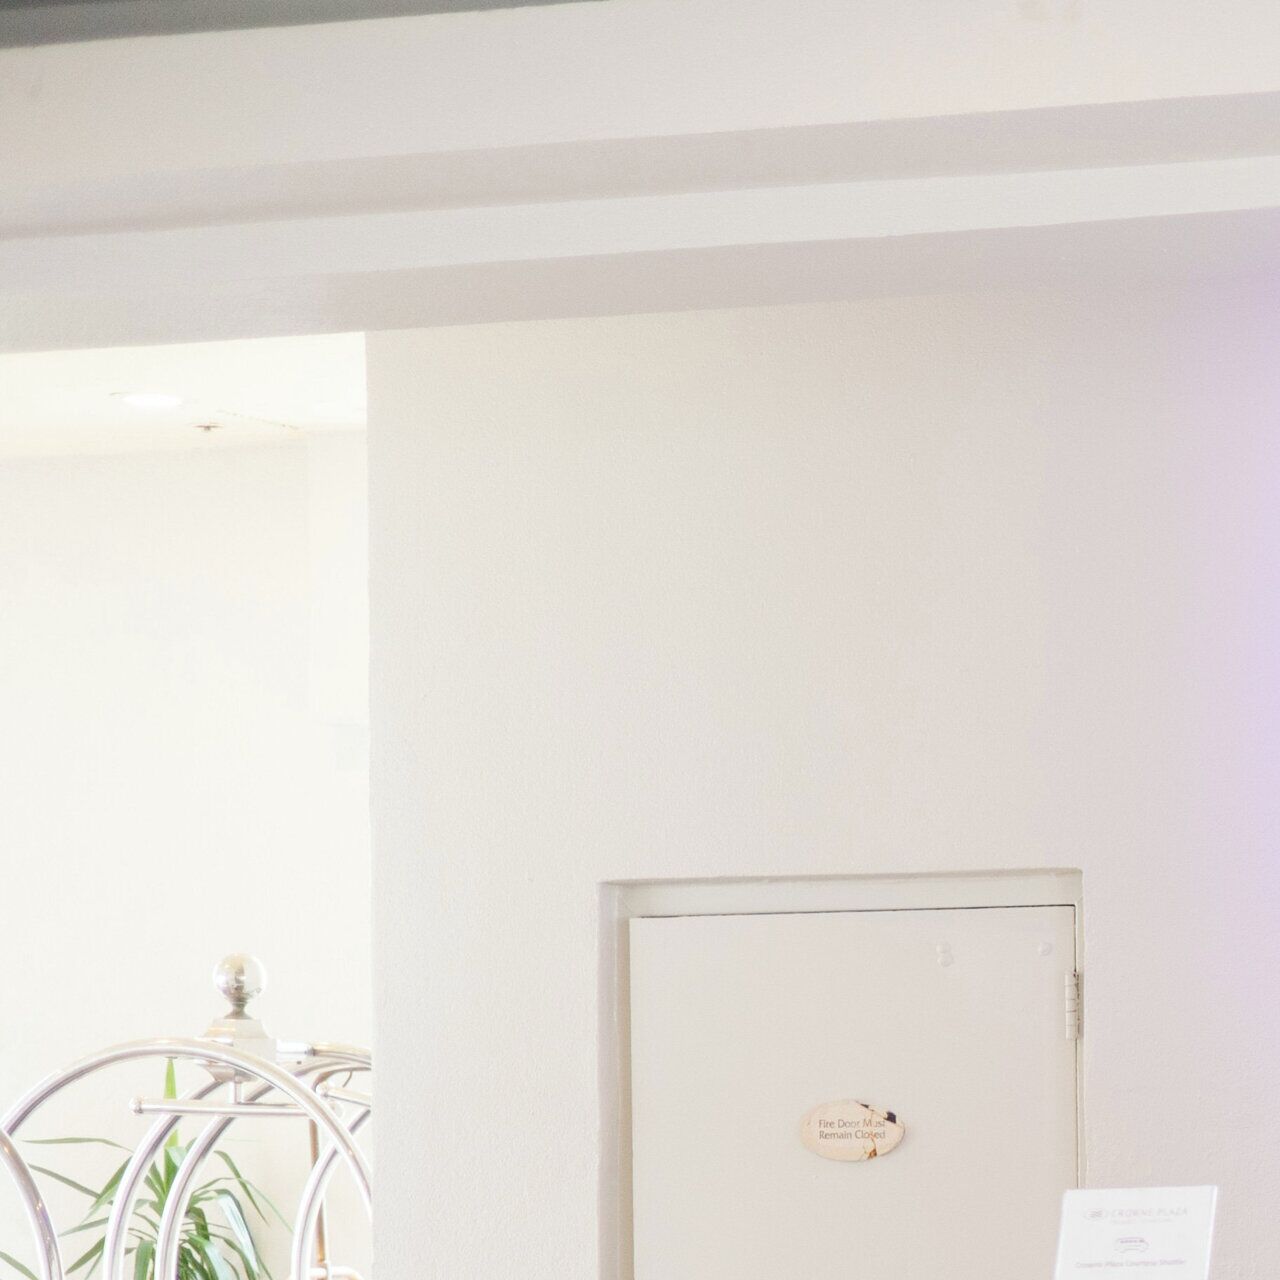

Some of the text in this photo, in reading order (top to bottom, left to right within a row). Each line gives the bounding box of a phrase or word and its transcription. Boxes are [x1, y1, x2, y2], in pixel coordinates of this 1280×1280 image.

[819, 1119, 835, 1129] Fire
[837, 1119, 860, 1129] Door
[819, 1130, 852, 1139] Remain
